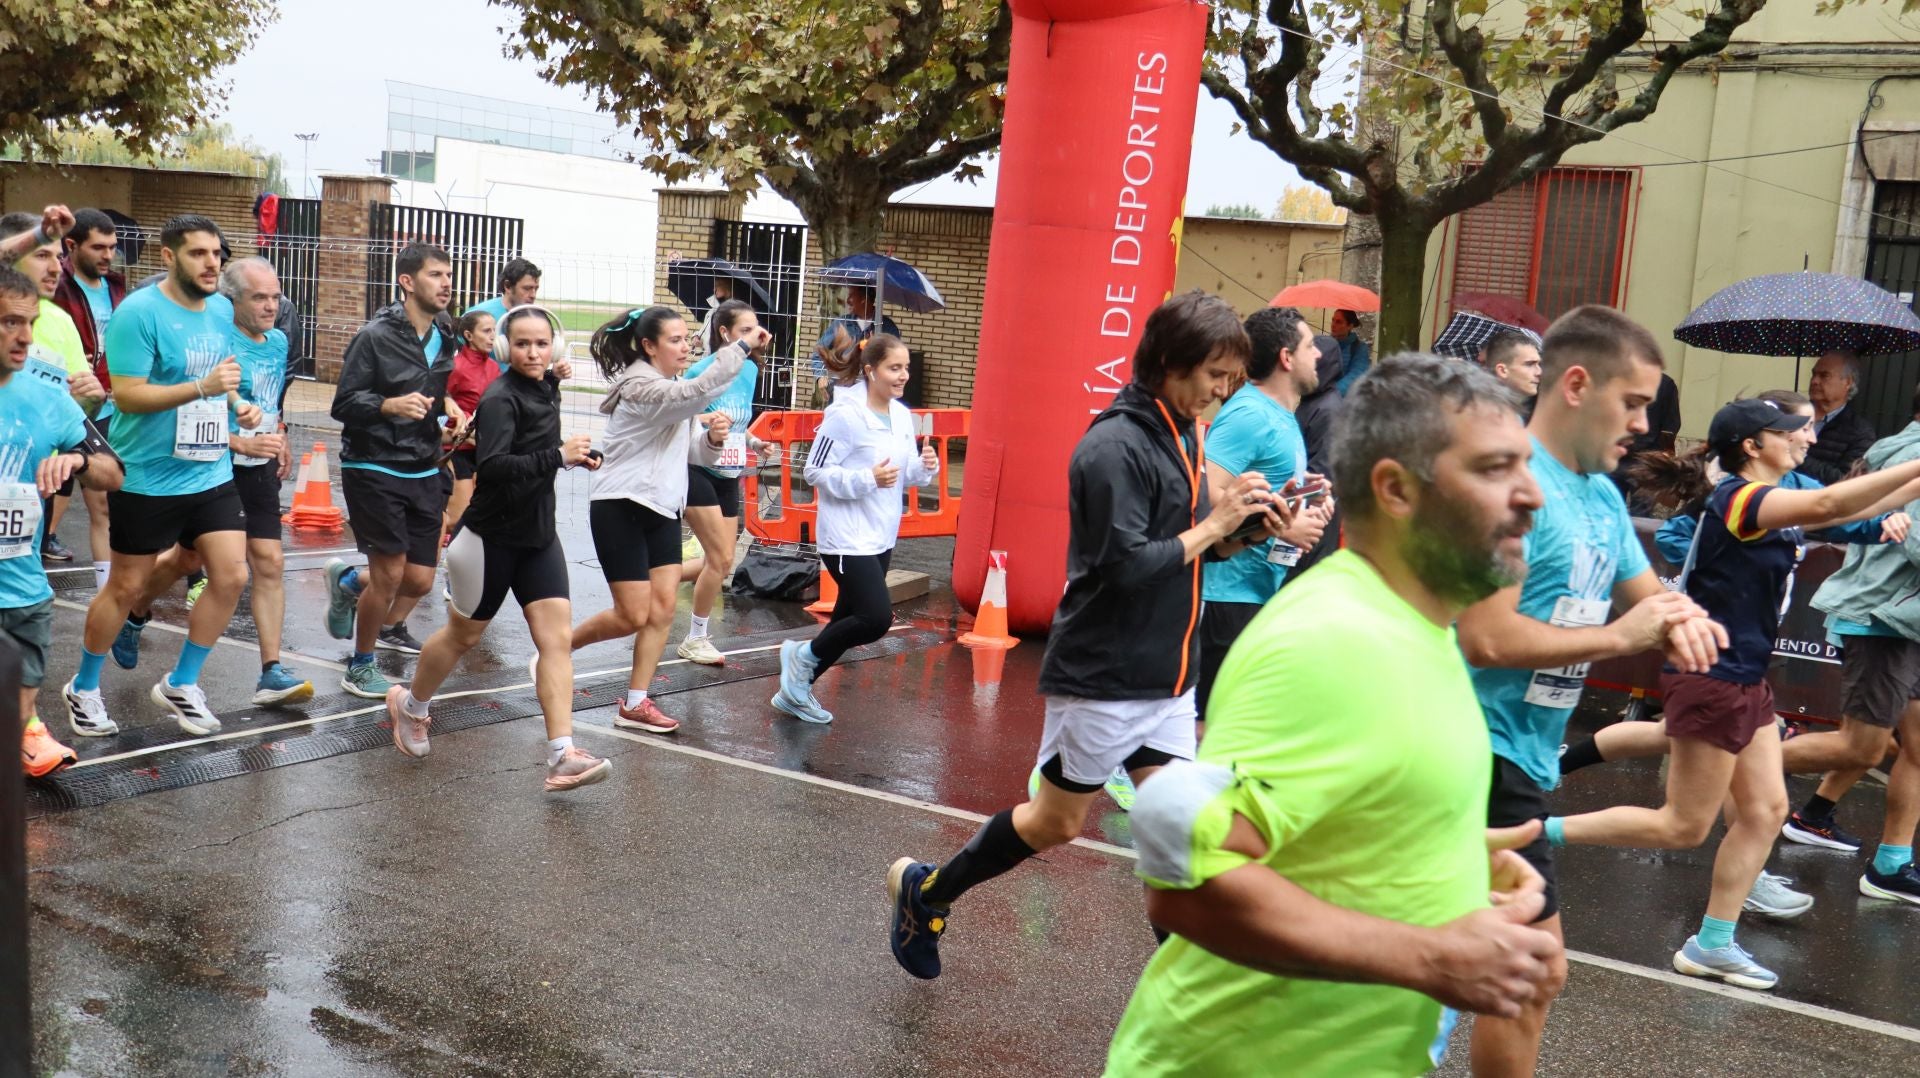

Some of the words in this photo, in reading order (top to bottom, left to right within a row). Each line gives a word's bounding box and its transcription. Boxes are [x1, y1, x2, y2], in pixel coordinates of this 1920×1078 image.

[1111, 52, 1167, 265] DEPORTES
[1101, 284, 1136, 337] DE
[1083, 356, 1126, 414] ÍA
[195, 421, 220, 443] 1101
